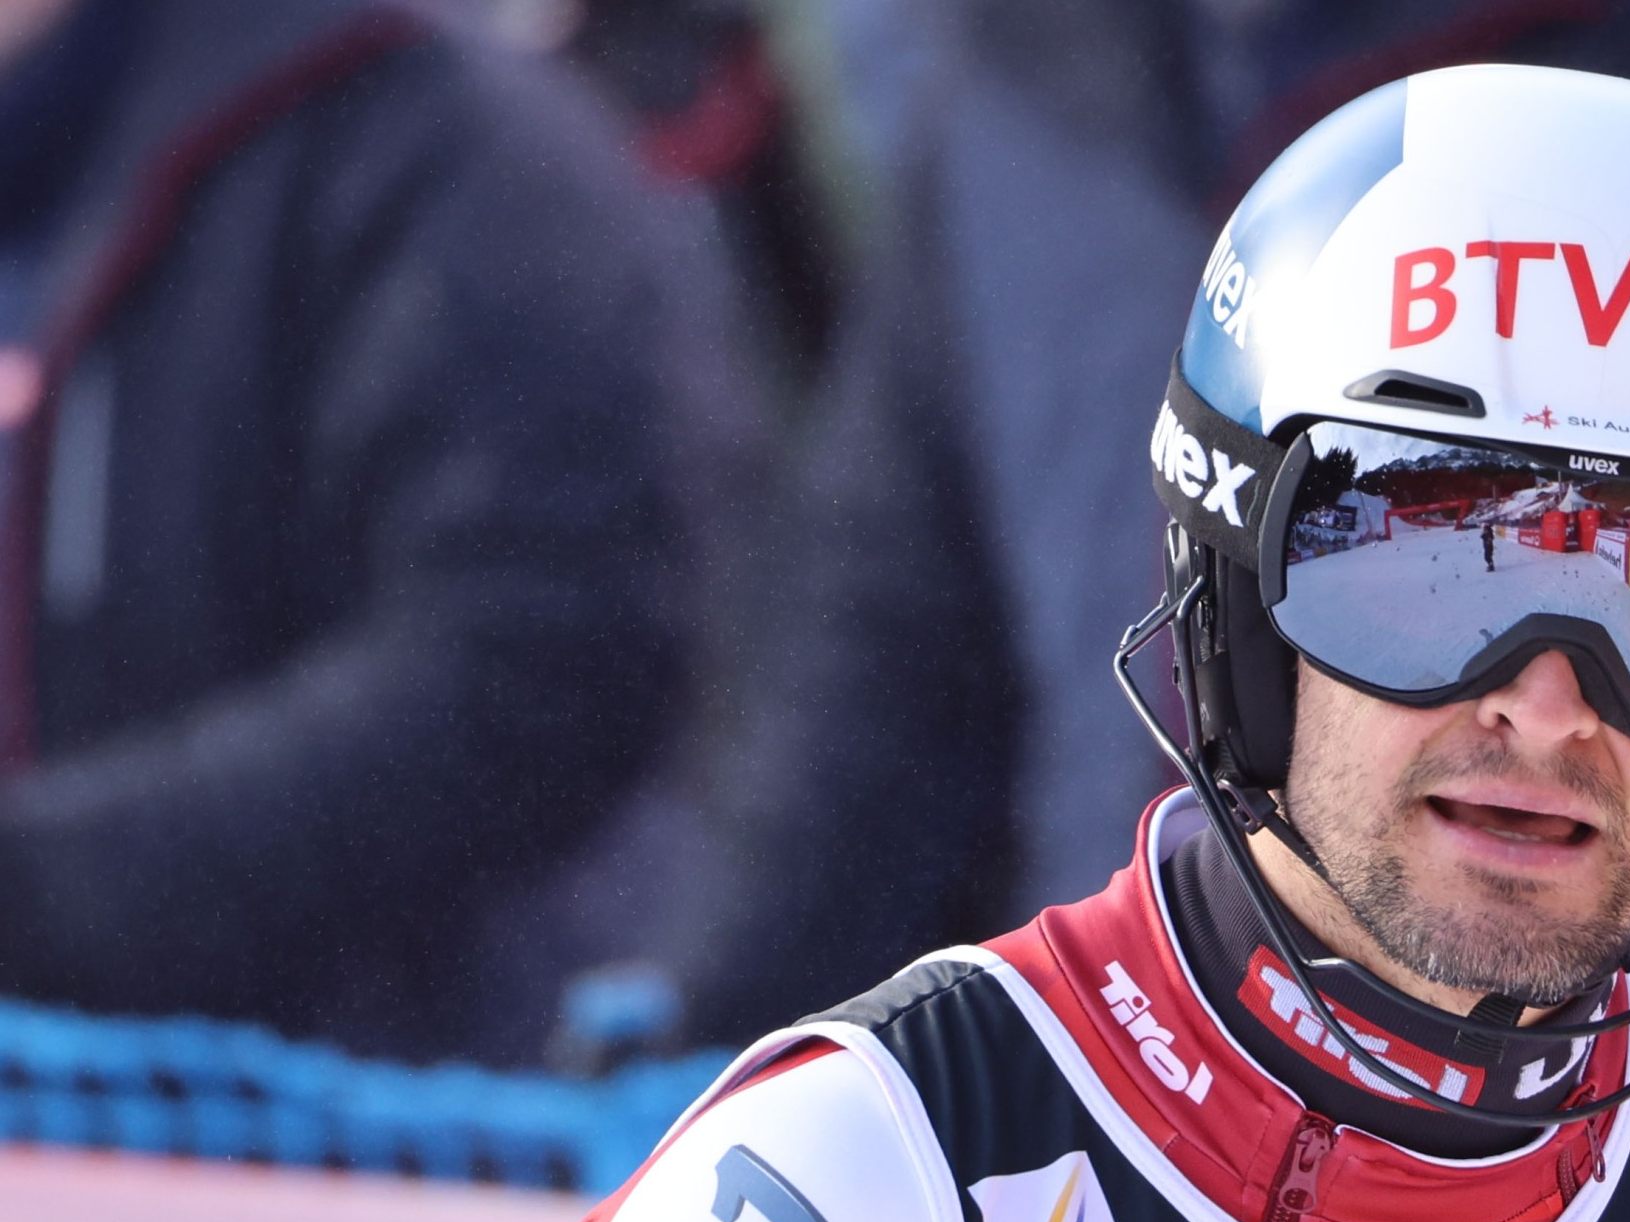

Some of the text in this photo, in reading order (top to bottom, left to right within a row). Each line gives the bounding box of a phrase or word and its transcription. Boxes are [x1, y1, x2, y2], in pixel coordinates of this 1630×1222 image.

[1567, 416, 1597, 429] Ski
[1569, 454, 1620, 476] uvex
[1099, 960, 1214, 1105] Tirol
[1260, 966, 1469, 1102] Tirol
